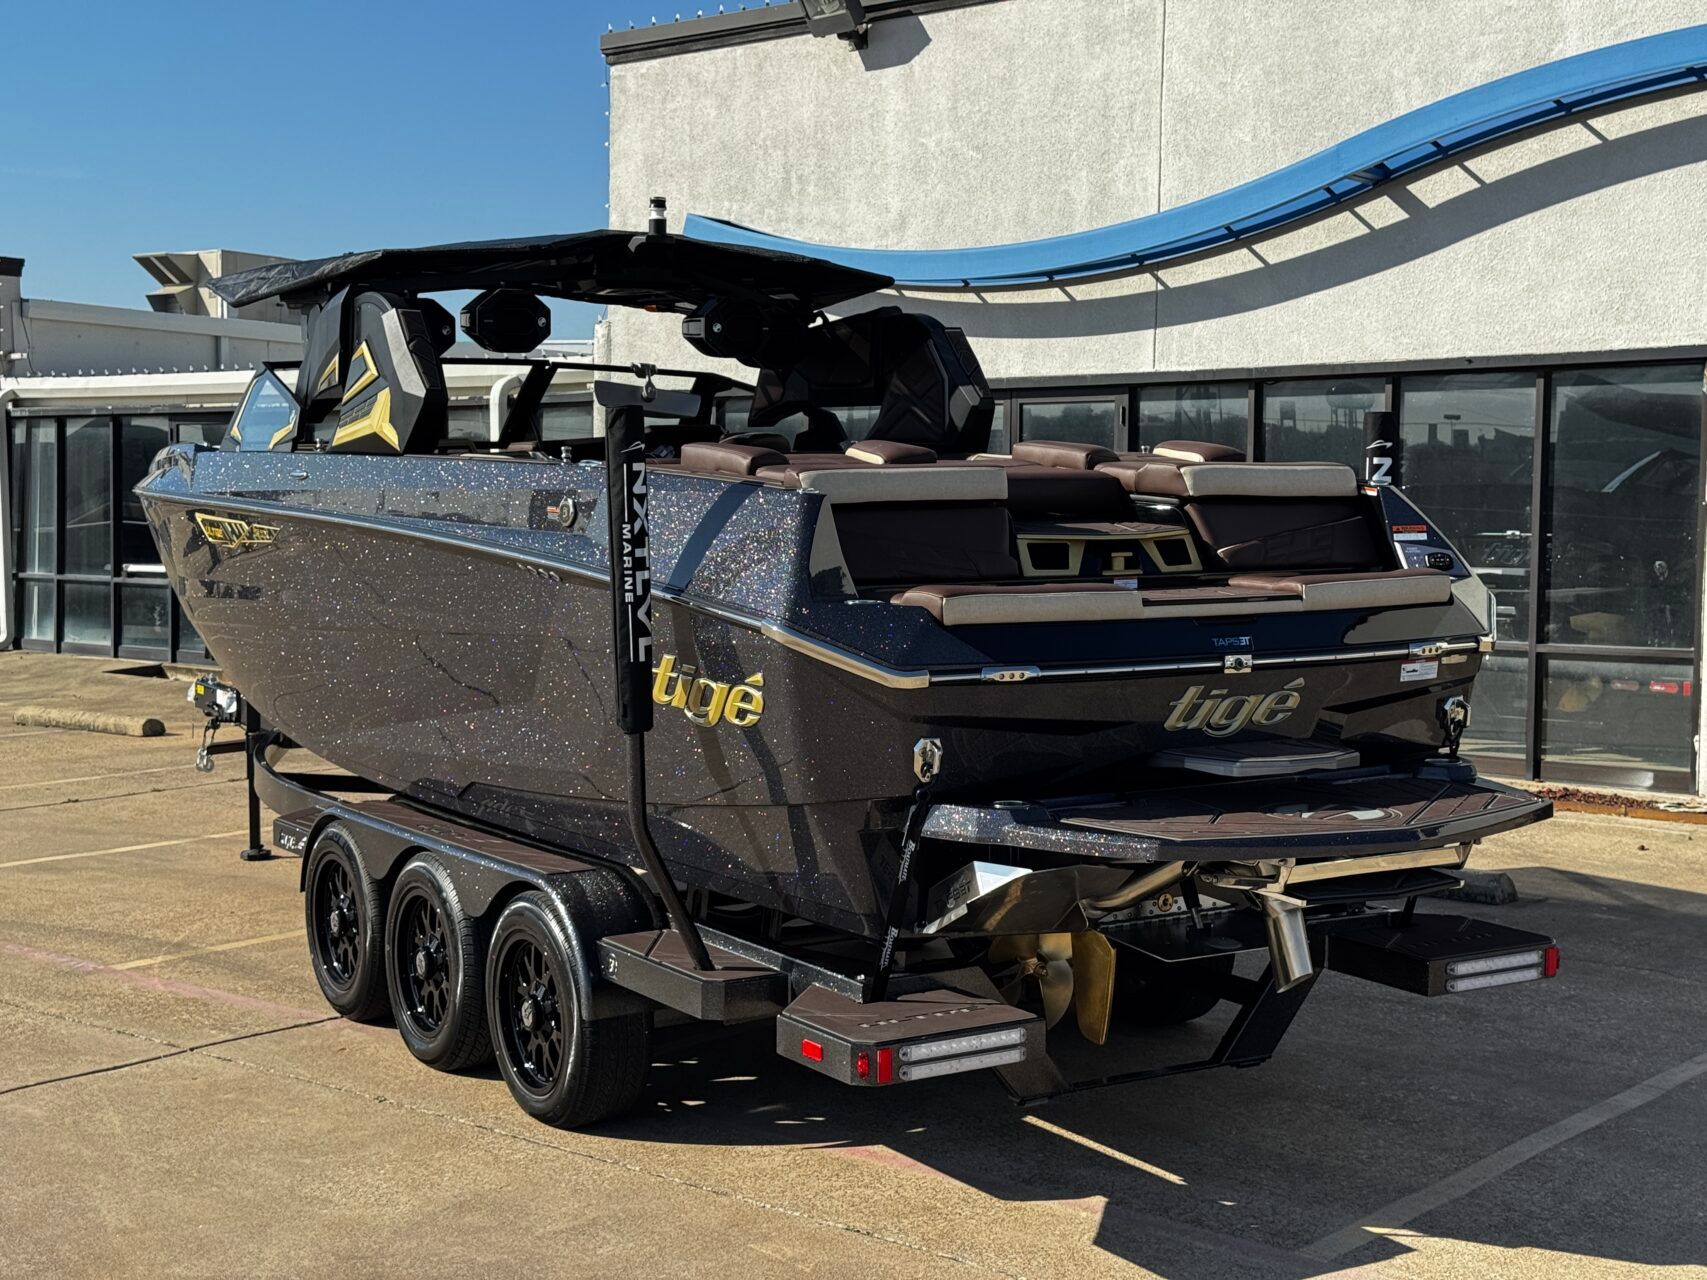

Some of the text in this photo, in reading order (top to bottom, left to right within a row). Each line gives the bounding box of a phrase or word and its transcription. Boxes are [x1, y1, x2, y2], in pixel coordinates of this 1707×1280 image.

[622, 524, 634, 603] MARINE
[632, 462, 652, 663] NXTLVL
[652, 653, 765, 728] tigé
[1163, 677, 1306, 738] tigé
